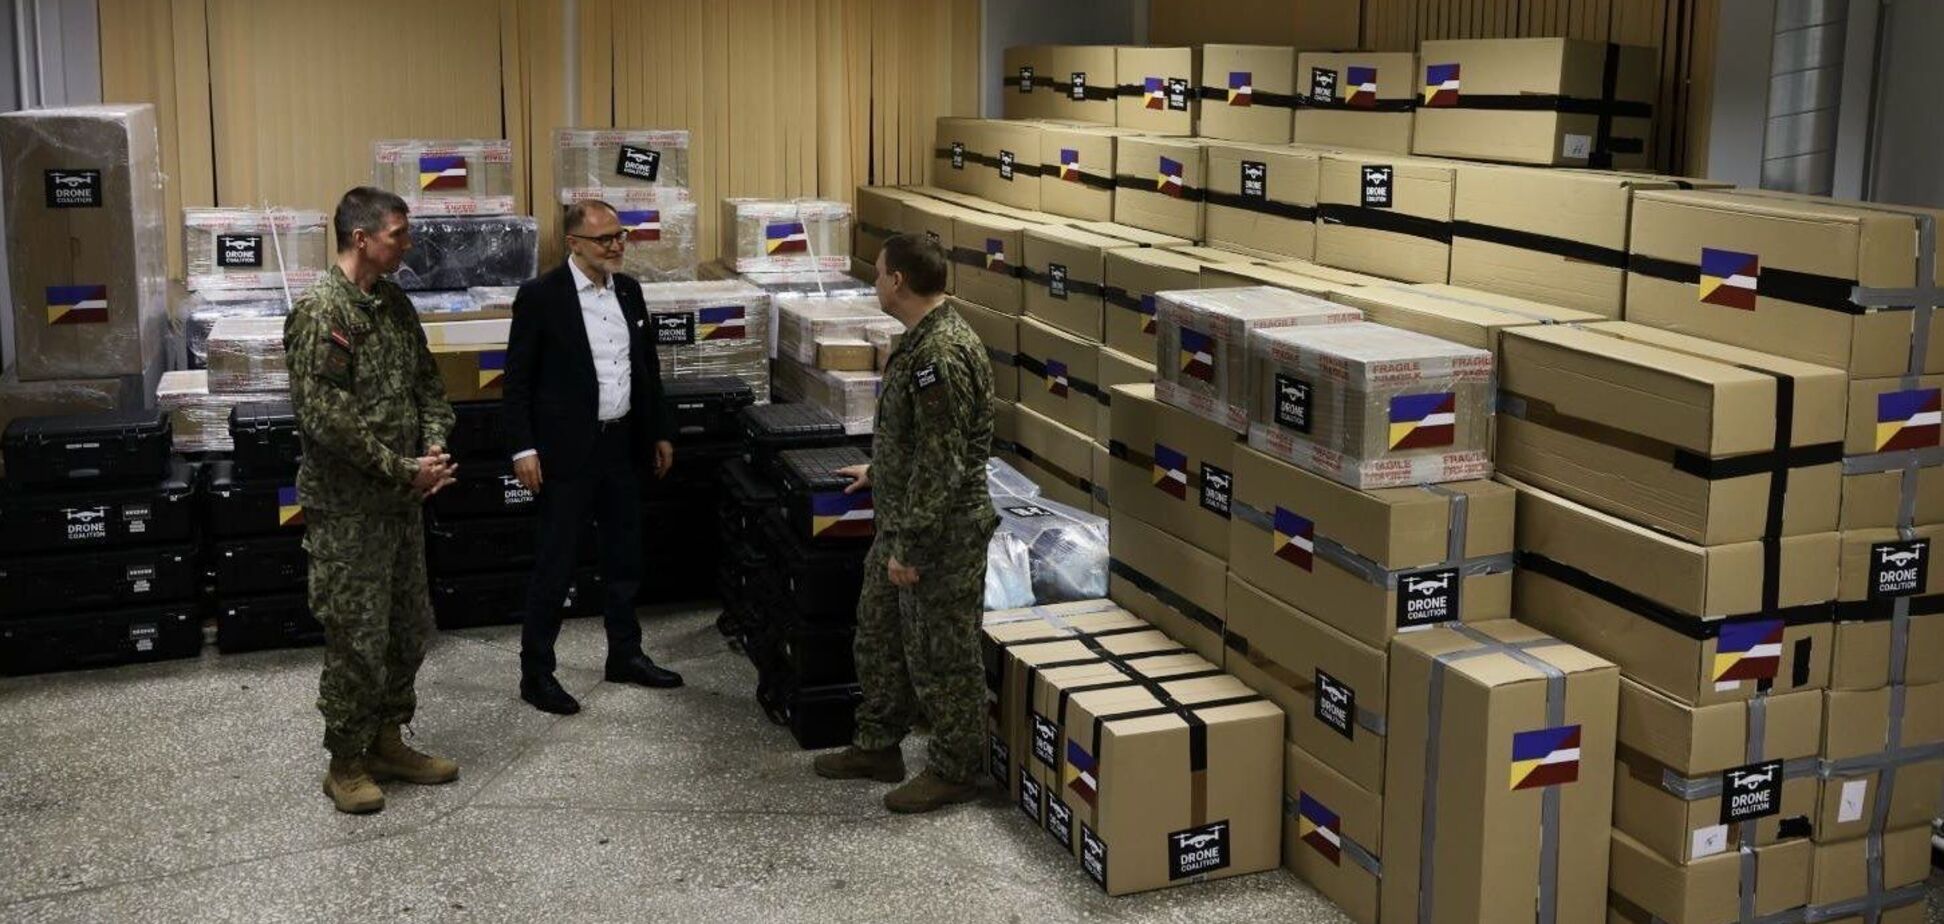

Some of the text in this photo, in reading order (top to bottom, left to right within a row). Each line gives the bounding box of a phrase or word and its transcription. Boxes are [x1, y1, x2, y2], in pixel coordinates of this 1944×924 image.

[625, 161, 650, 173] DRONE
[56, 189, 92, 198] DRONE
[1366, 186, 1387, 197] DRONE
[226, 250, 255, 258] DRONE
[1253, 317, 1297, 329] FRAGILE
[659, 328, 686, 337] DRONE
[1373, 362, 1420, 374] FRAGILE
[1452, 357, 1491, 369] FRAGIL
[1282, 400, 1304, 418] DRONE
[505, 489, 533, 499] DRON
[1206, 487, 1229, 508] DRONE
[68, 522, 106, 534] DRONE
[68, 531, 106, 540] COALITION
[1880, 567, 1918, 583] DRONE
[1880, 579, 1917, 592] COALITION
[1408, 596, 1447, 611] DRONE
[1408, 607, 1447, 620] COALITION
[1321, 696, 1346, 721] DRONE
[1732, 789, 1771, 808] DRONE
[1732, 801, 1770, 816] COALITION
[1181, 846, 1219, 864] DRONE
[1181, 857, 1220, 872] COALITION
